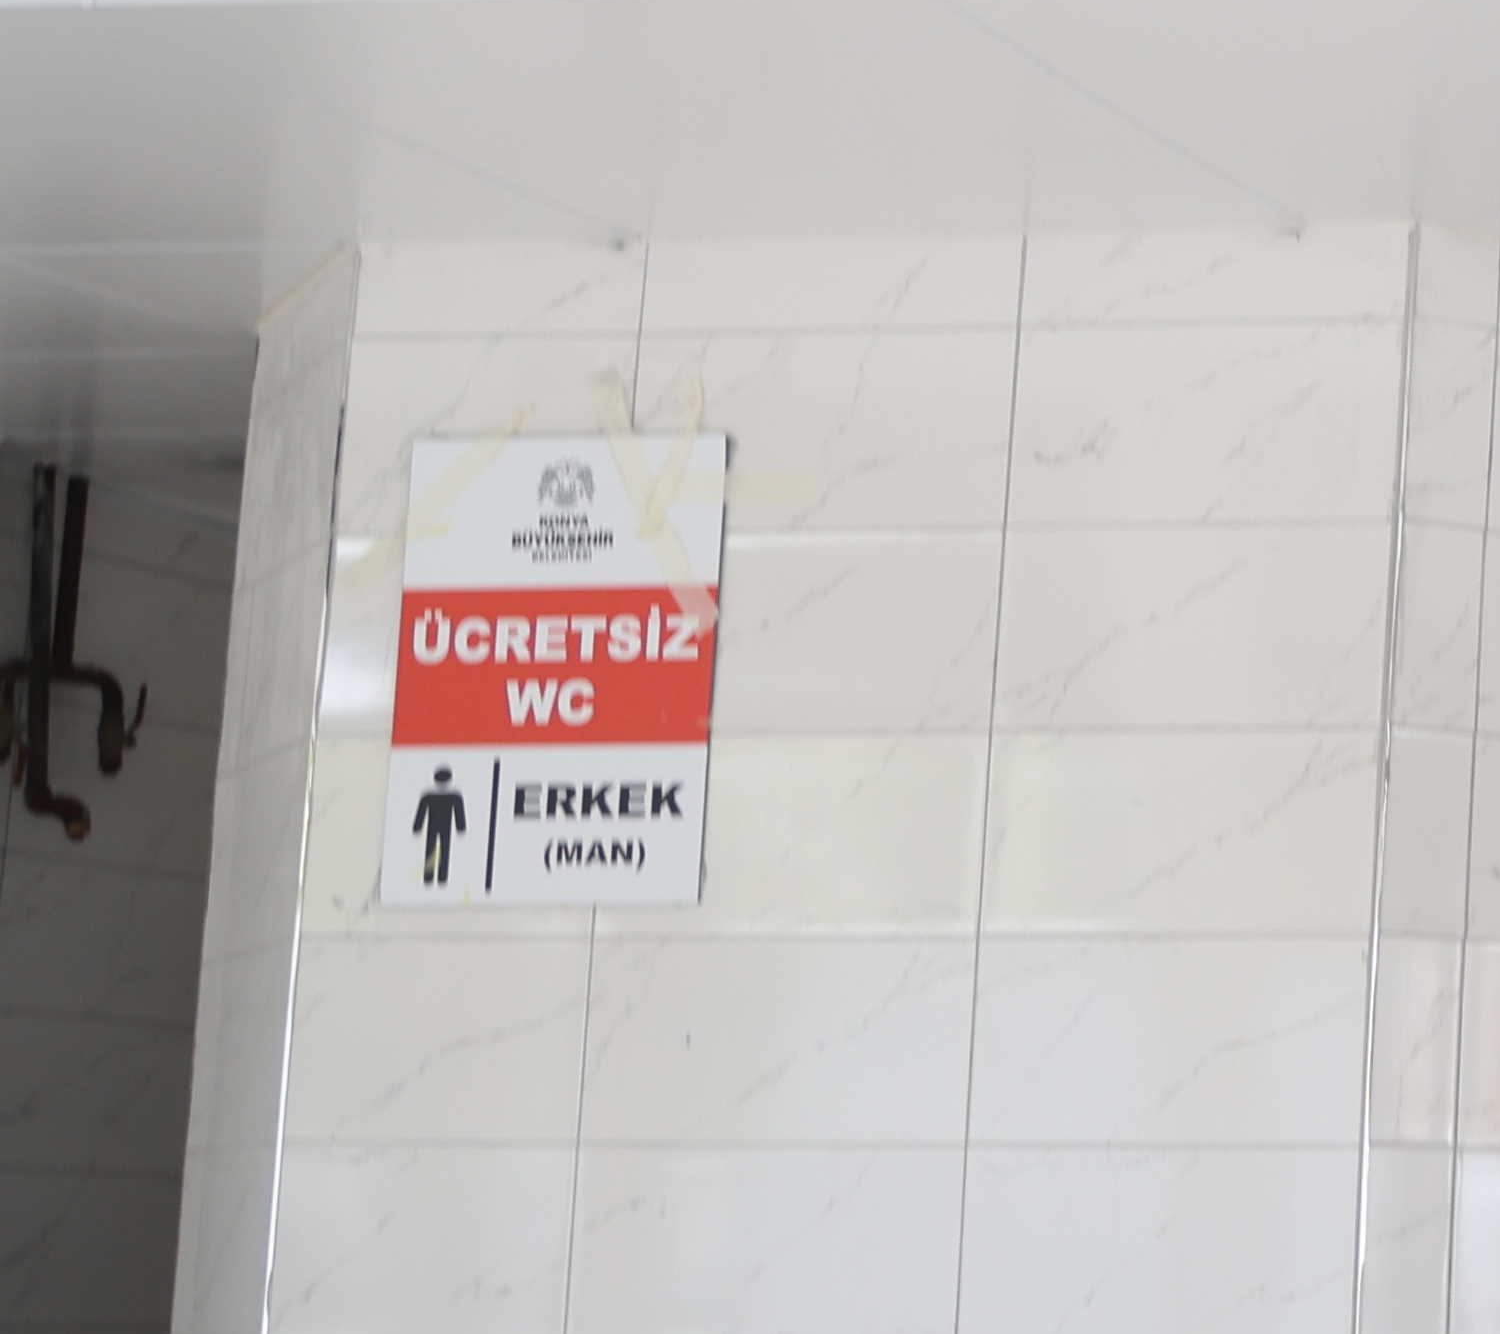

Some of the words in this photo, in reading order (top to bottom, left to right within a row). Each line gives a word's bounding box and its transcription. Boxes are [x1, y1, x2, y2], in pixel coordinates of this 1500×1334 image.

[411, 605, 700, 665] ÜCRETSİZ
[506, 679, 596, 727] WC
[512, 780, 685, 821] ERKEK
[543, 837, 647, 873] (MAN)
